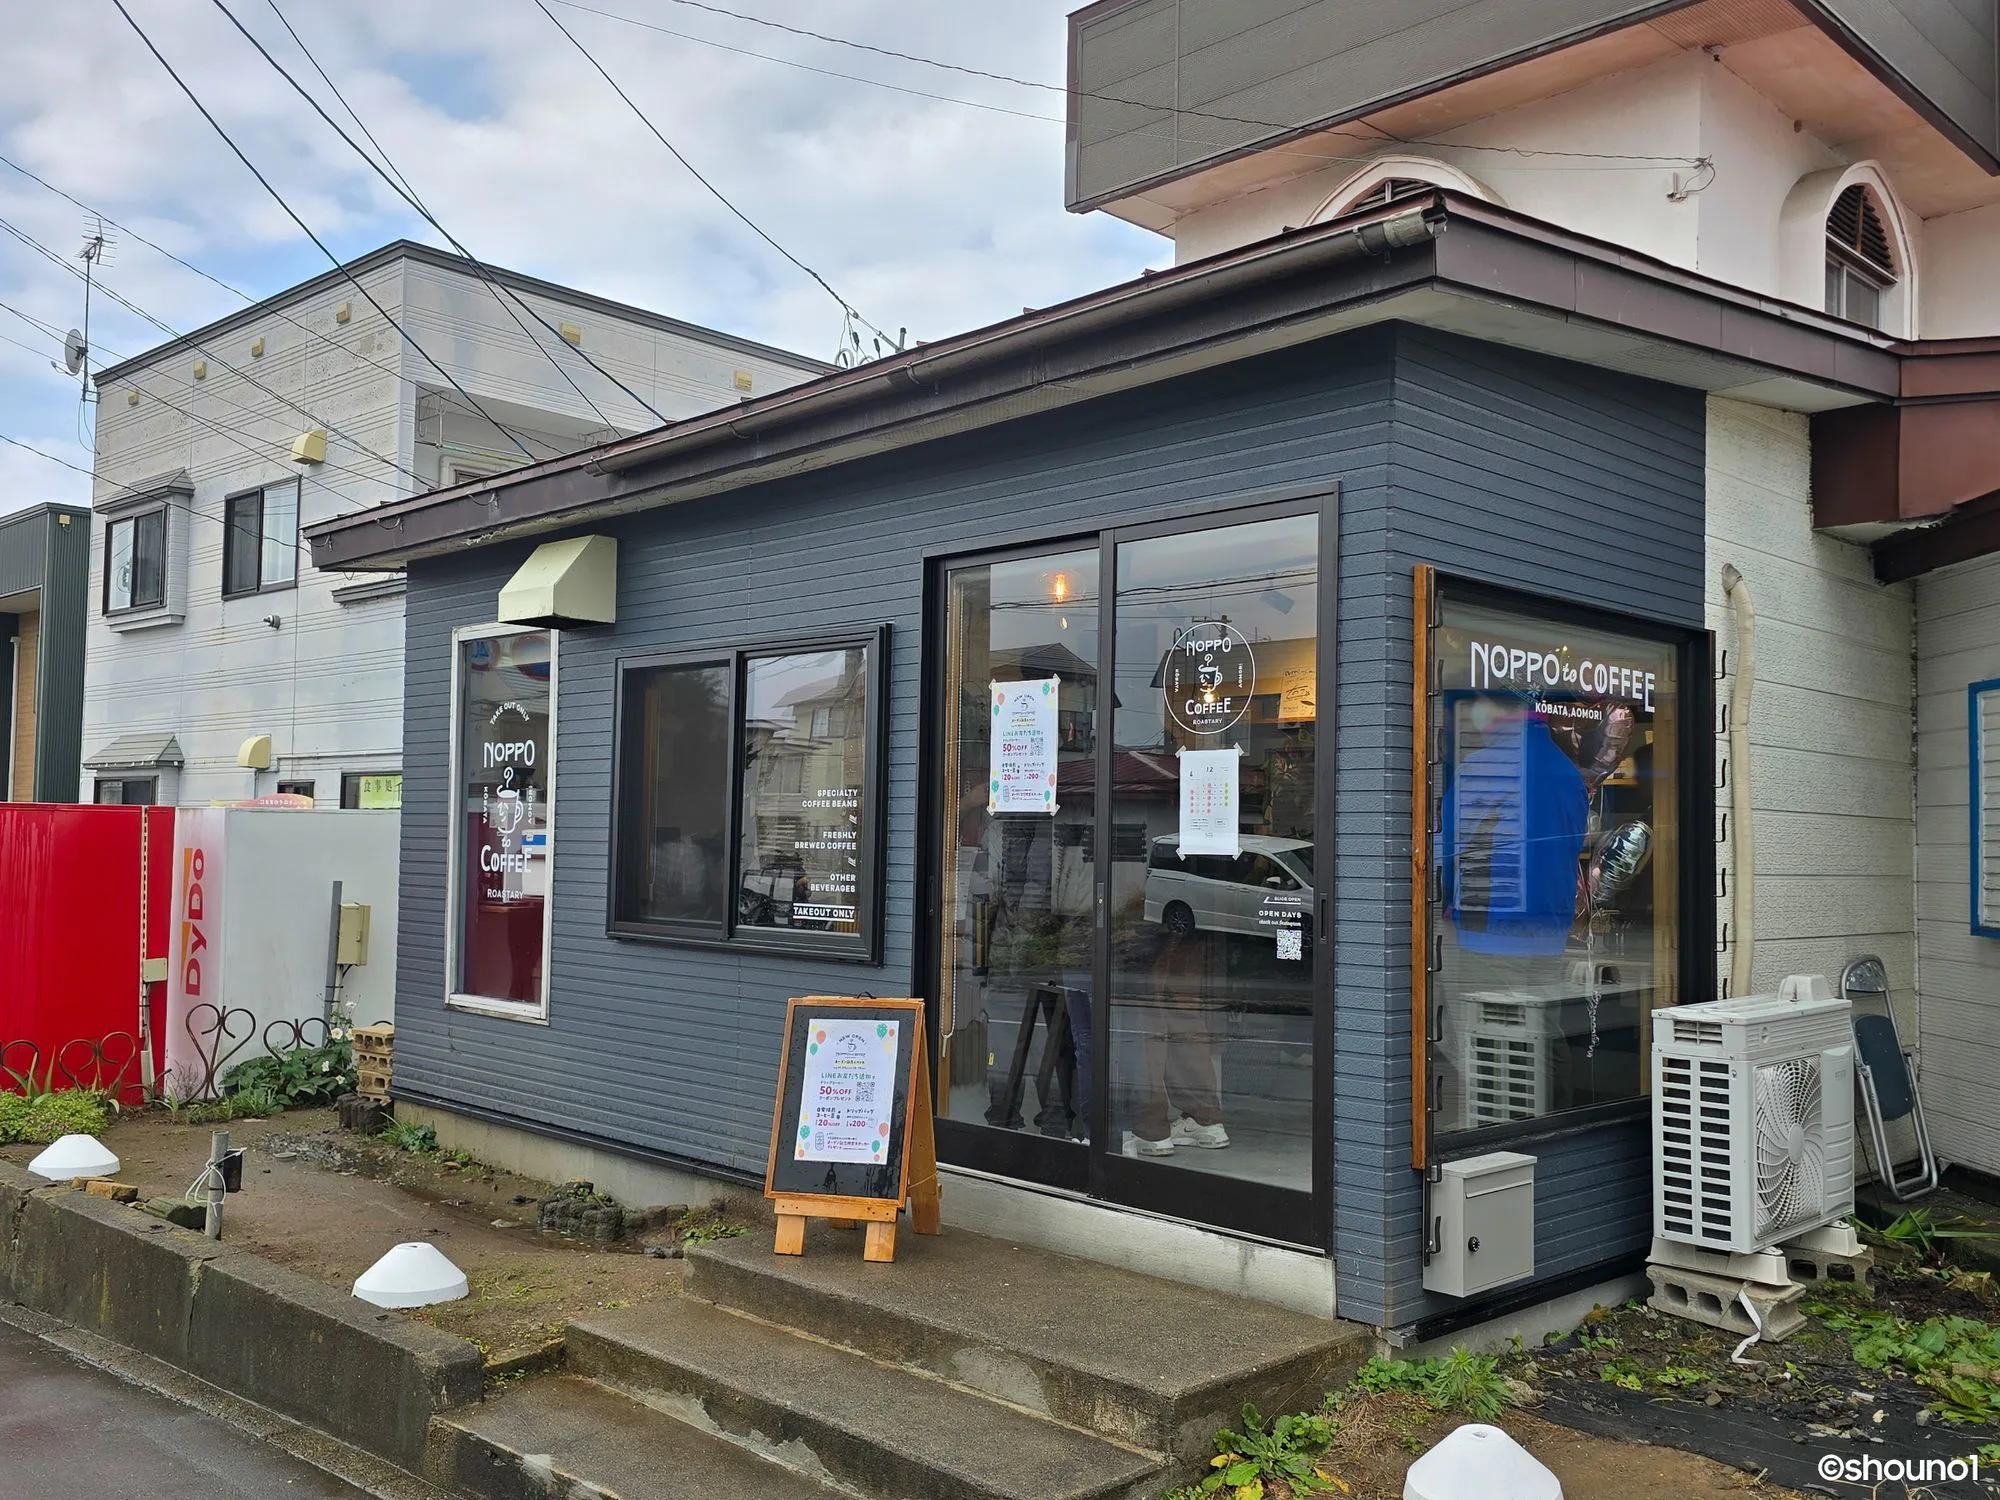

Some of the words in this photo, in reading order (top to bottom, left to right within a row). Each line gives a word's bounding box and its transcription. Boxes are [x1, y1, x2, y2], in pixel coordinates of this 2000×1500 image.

[1187, 637, 1231, 656] NOPPO
[1471, 642, 1560, 689] NOPPO
[1562, 663, 1577, 682] to
[1579, 660, 1655, 712] COFFEE
[1186, 698, 1231, 715] COFFEE
[490, 706, 503, 725] TAKE
[504, 702, 516, 710] OUT
[516, 704, 530, 722] ONLY
[484, 740, 535, 768] NOPPO
[817, 789, 858, 797] SPECIALTY
[827, 842, 856, 850] COFFEE
[481, 845, 532, 872] COFFEE
[830, 874, 856, 882] OTHER
[487, 888, 524, 900] ROASTARY
[811, 884, 856, 892] BEVERAGES
[793, 907, 831, 917] TAKEOUT
[833, 909, 855, 918] ONLY
[820, 1086, 852, 1095] 50%OFF
